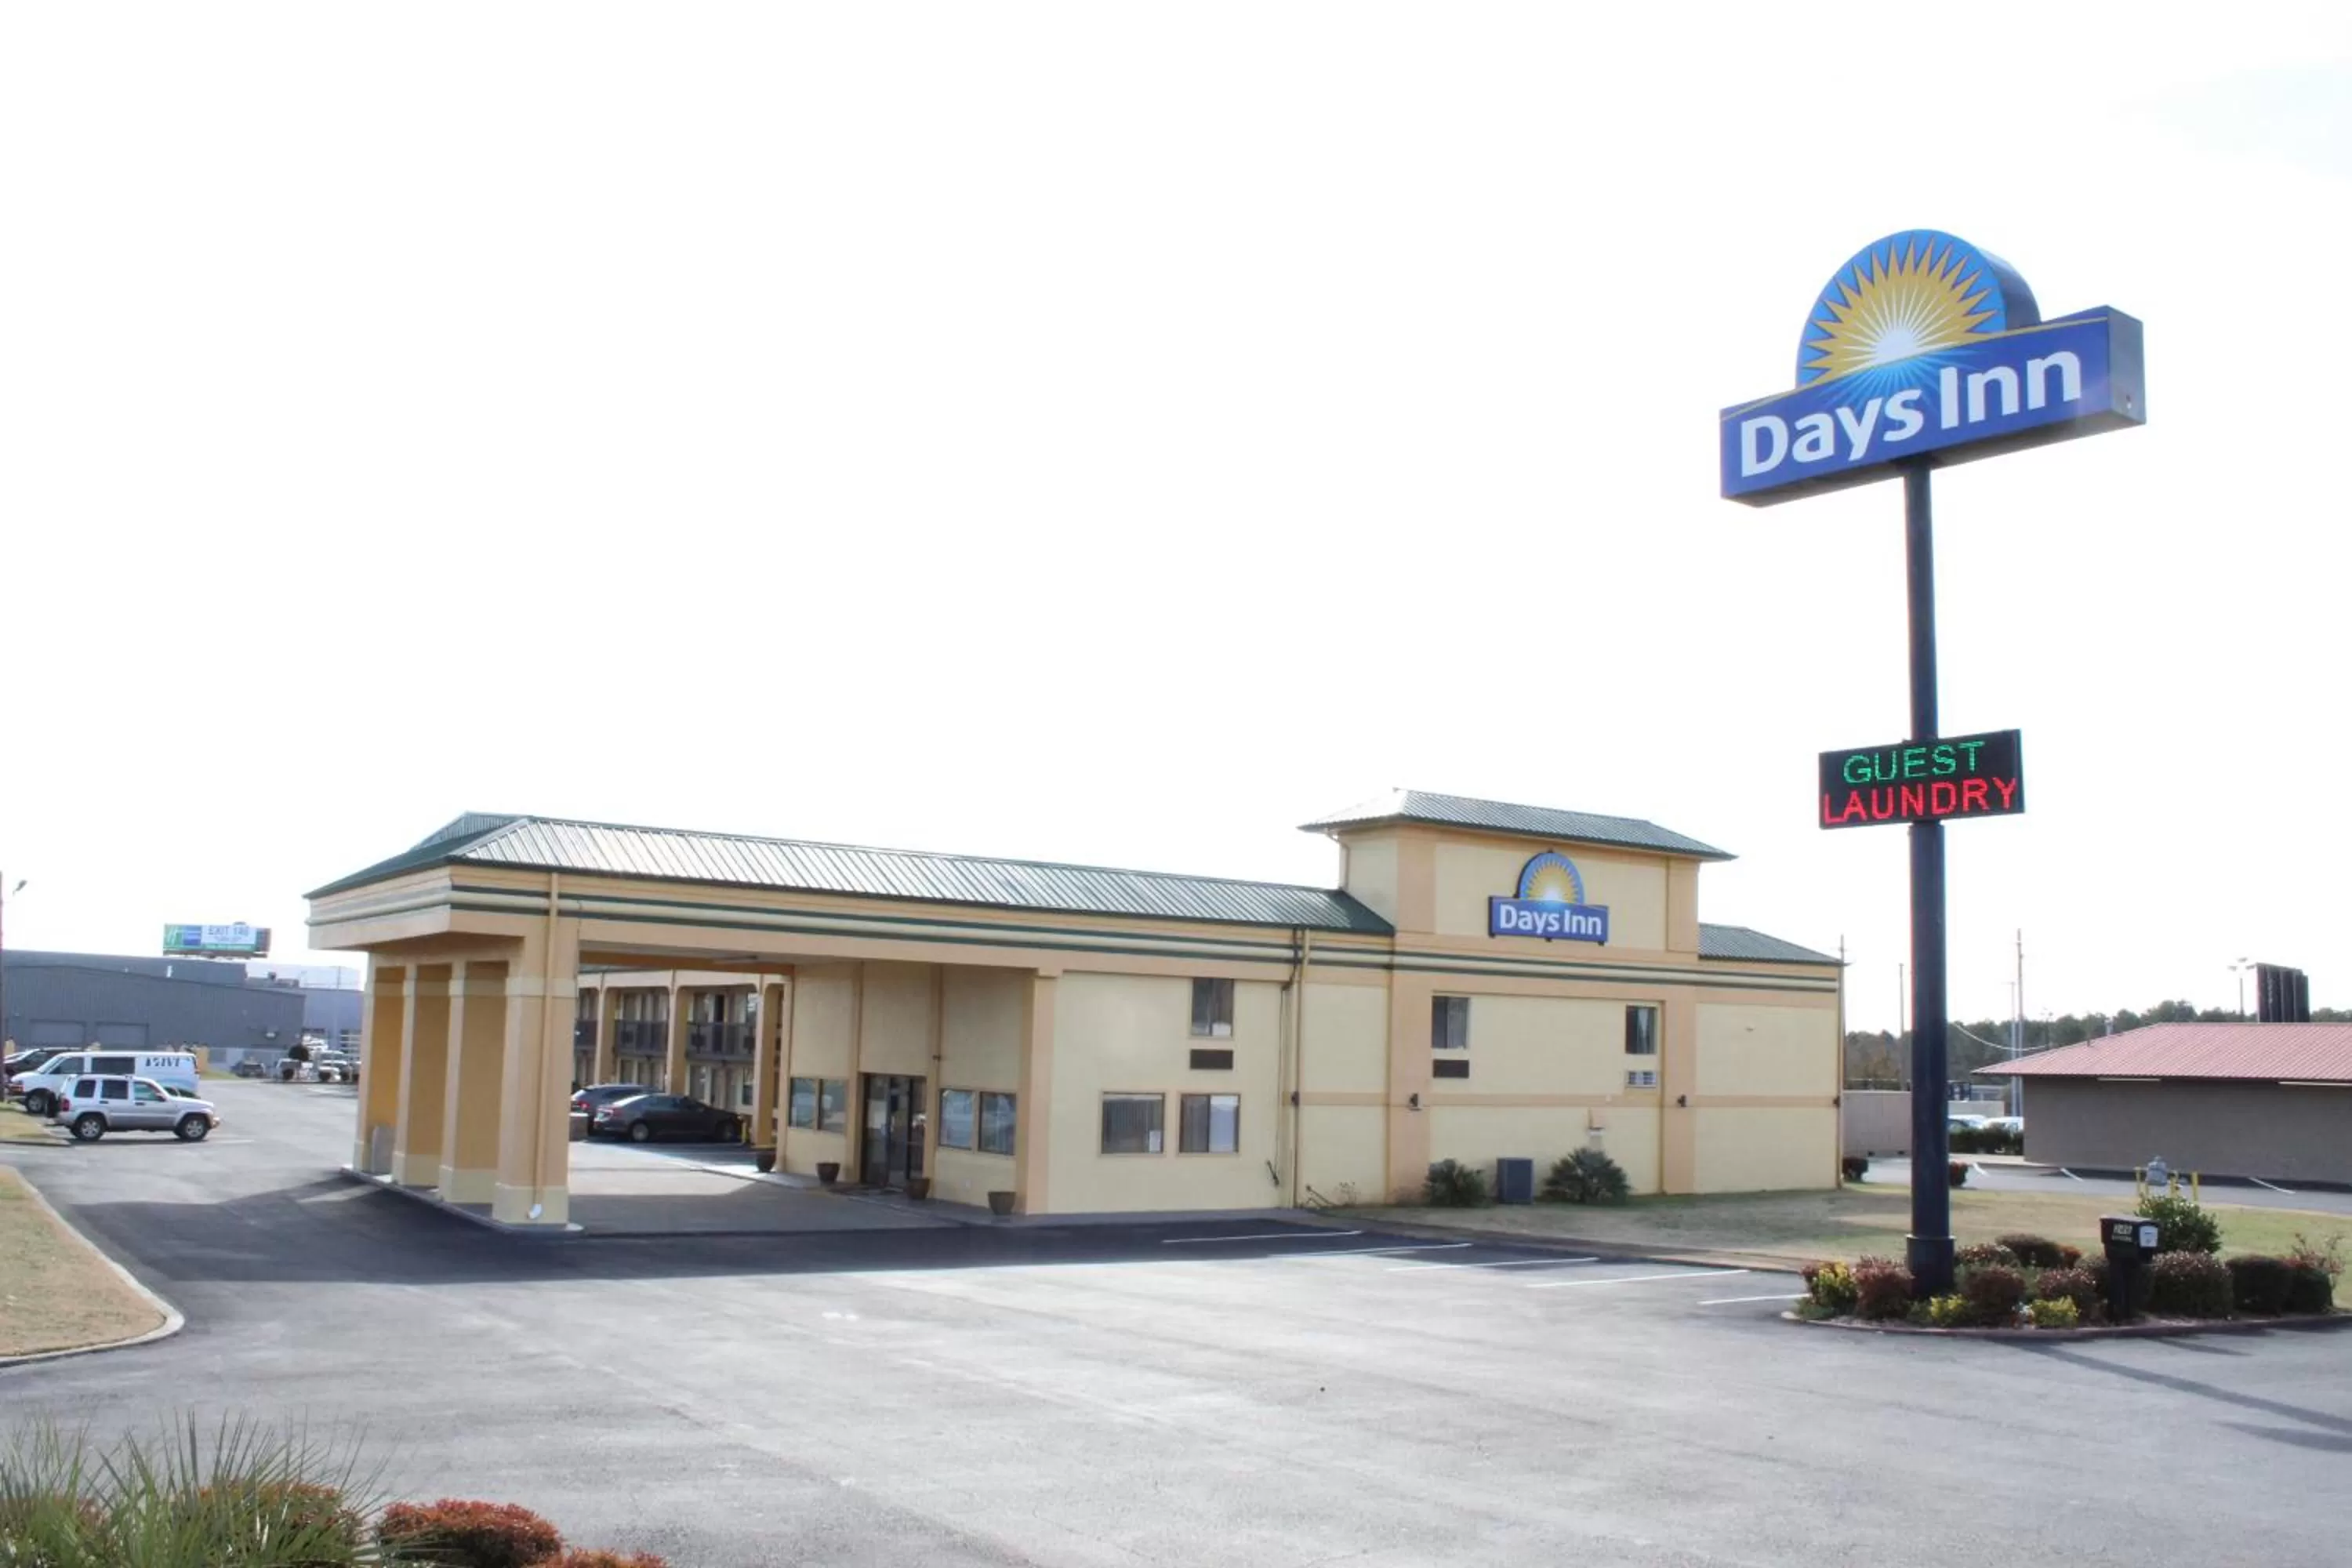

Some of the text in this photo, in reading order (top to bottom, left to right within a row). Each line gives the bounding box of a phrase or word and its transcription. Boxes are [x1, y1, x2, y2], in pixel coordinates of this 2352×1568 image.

[1740, 350, 2082, 477] Days Inn
[1843, 741, 1986, 784] GUEST
[1824, 777, 2017, 826] LAUNDRY
[1499, 903, 1602, 936] Days Inn
